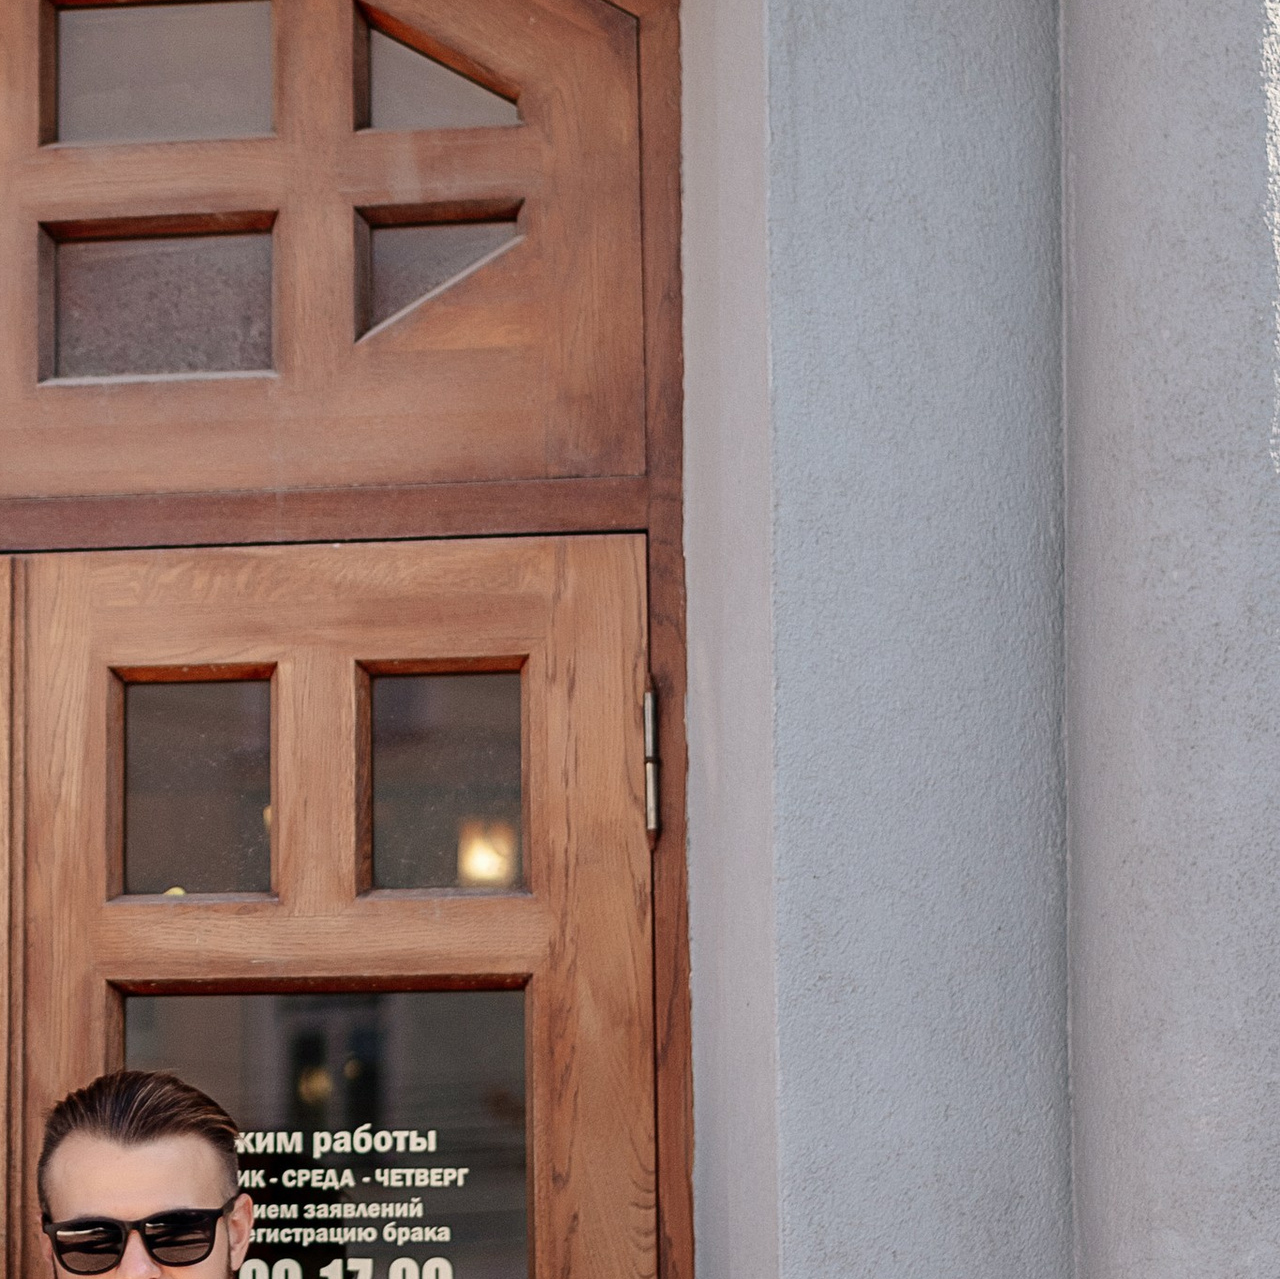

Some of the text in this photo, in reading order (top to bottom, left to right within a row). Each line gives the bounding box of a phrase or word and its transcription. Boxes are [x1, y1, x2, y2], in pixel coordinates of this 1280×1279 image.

[312, 1123, 438, 1159] работы
[281, 1168, 356, 1191] СРЕДА
[374, 1168, 470, 1187] ЧЕТВЕРГ
[303, 1197, 424, 1219] заявлений
[382, 1221, 451, 1246] брака
